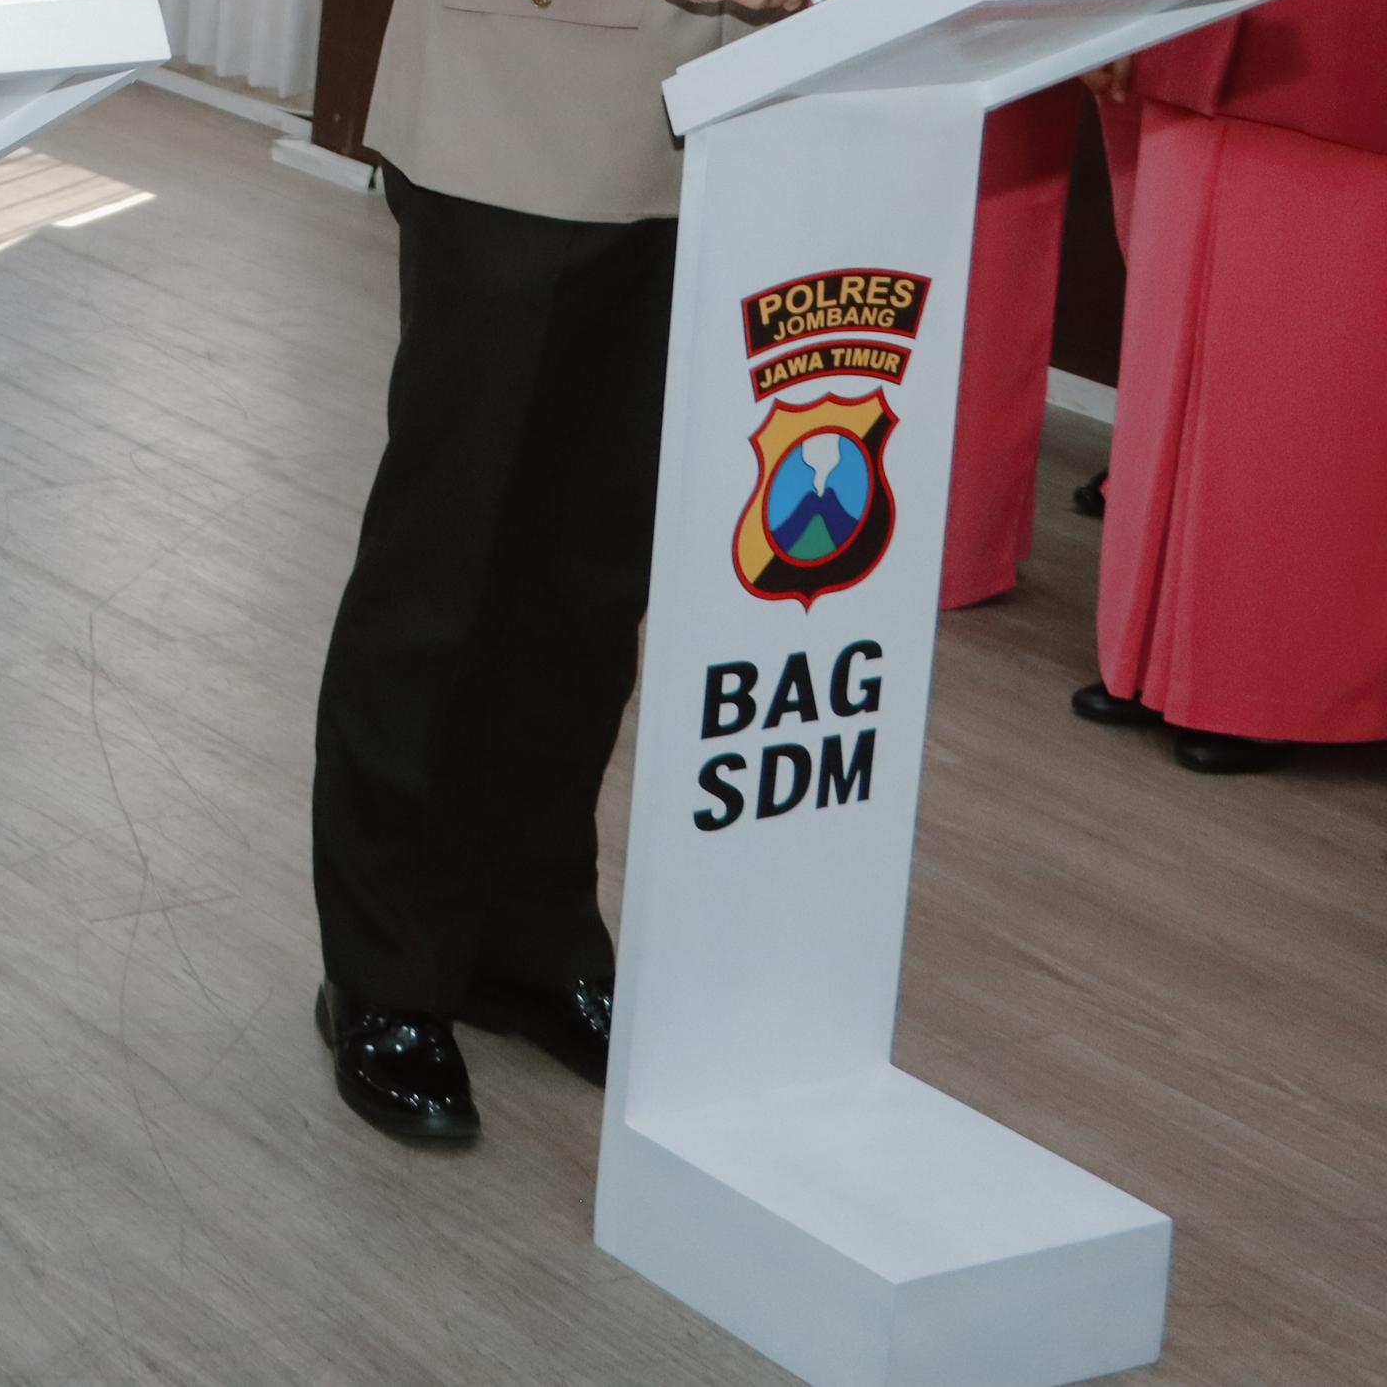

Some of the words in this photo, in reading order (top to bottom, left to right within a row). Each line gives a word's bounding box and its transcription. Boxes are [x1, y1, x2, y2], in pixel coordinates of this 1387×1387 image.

[759, 276, 915, 325] POLRES
[773, 306, 896, 341] JOMBANG
[759, 351, 824, 389] JAWA
[831, 348, 901, 373] TIMUR
[701, 639, 883, 740] BAG
[693, 727, 876, 832] SDM
